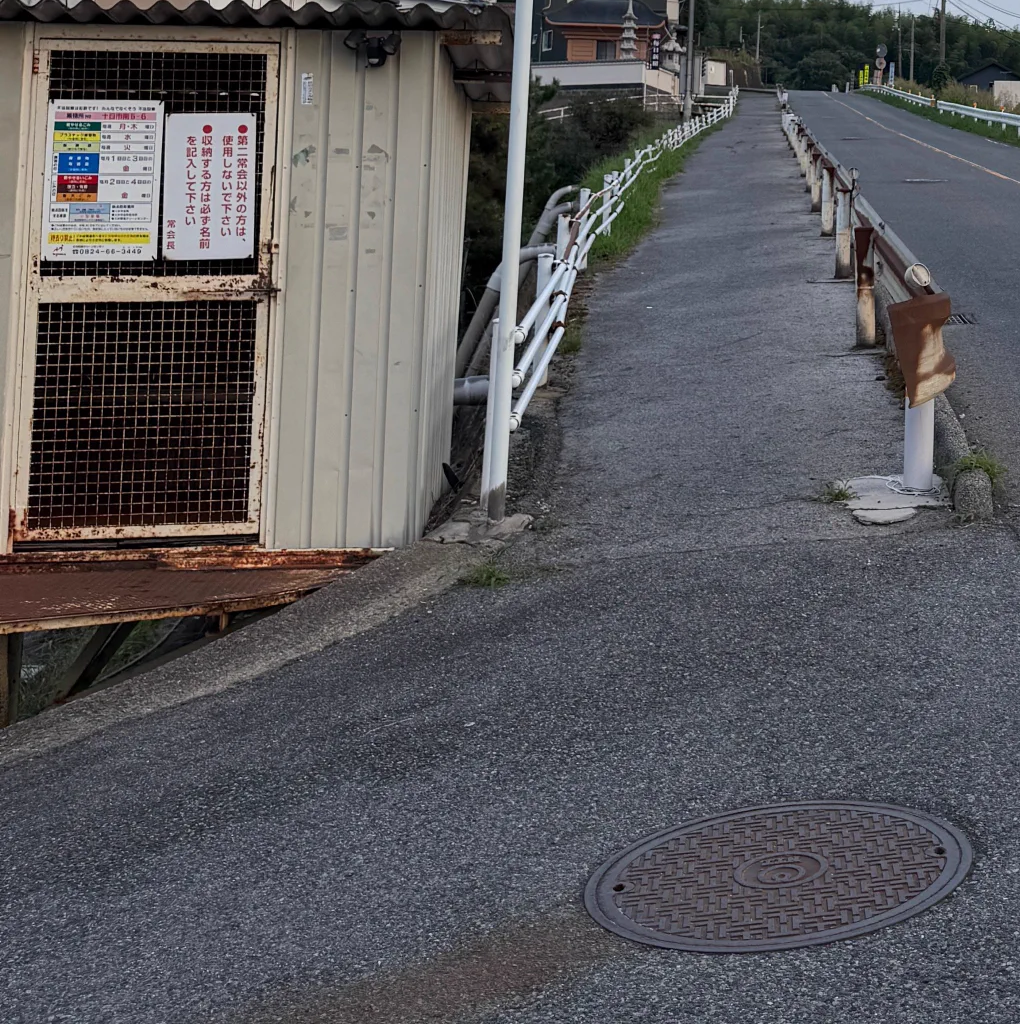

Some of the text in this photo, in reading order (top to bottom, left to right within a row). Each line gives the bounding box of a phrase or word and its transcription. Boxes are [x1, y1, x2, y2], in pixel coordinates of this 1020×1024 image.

[185, 136, 198, 226] を記入して下さい
[199, 135, 213, 250] 収納する方は必ず名前
[220, 135, 234, 237] 使用しないで下さい
[235, 135, 248, 243] 第二常会以外の方は、
[166, 219, 177, 250] 常会長
